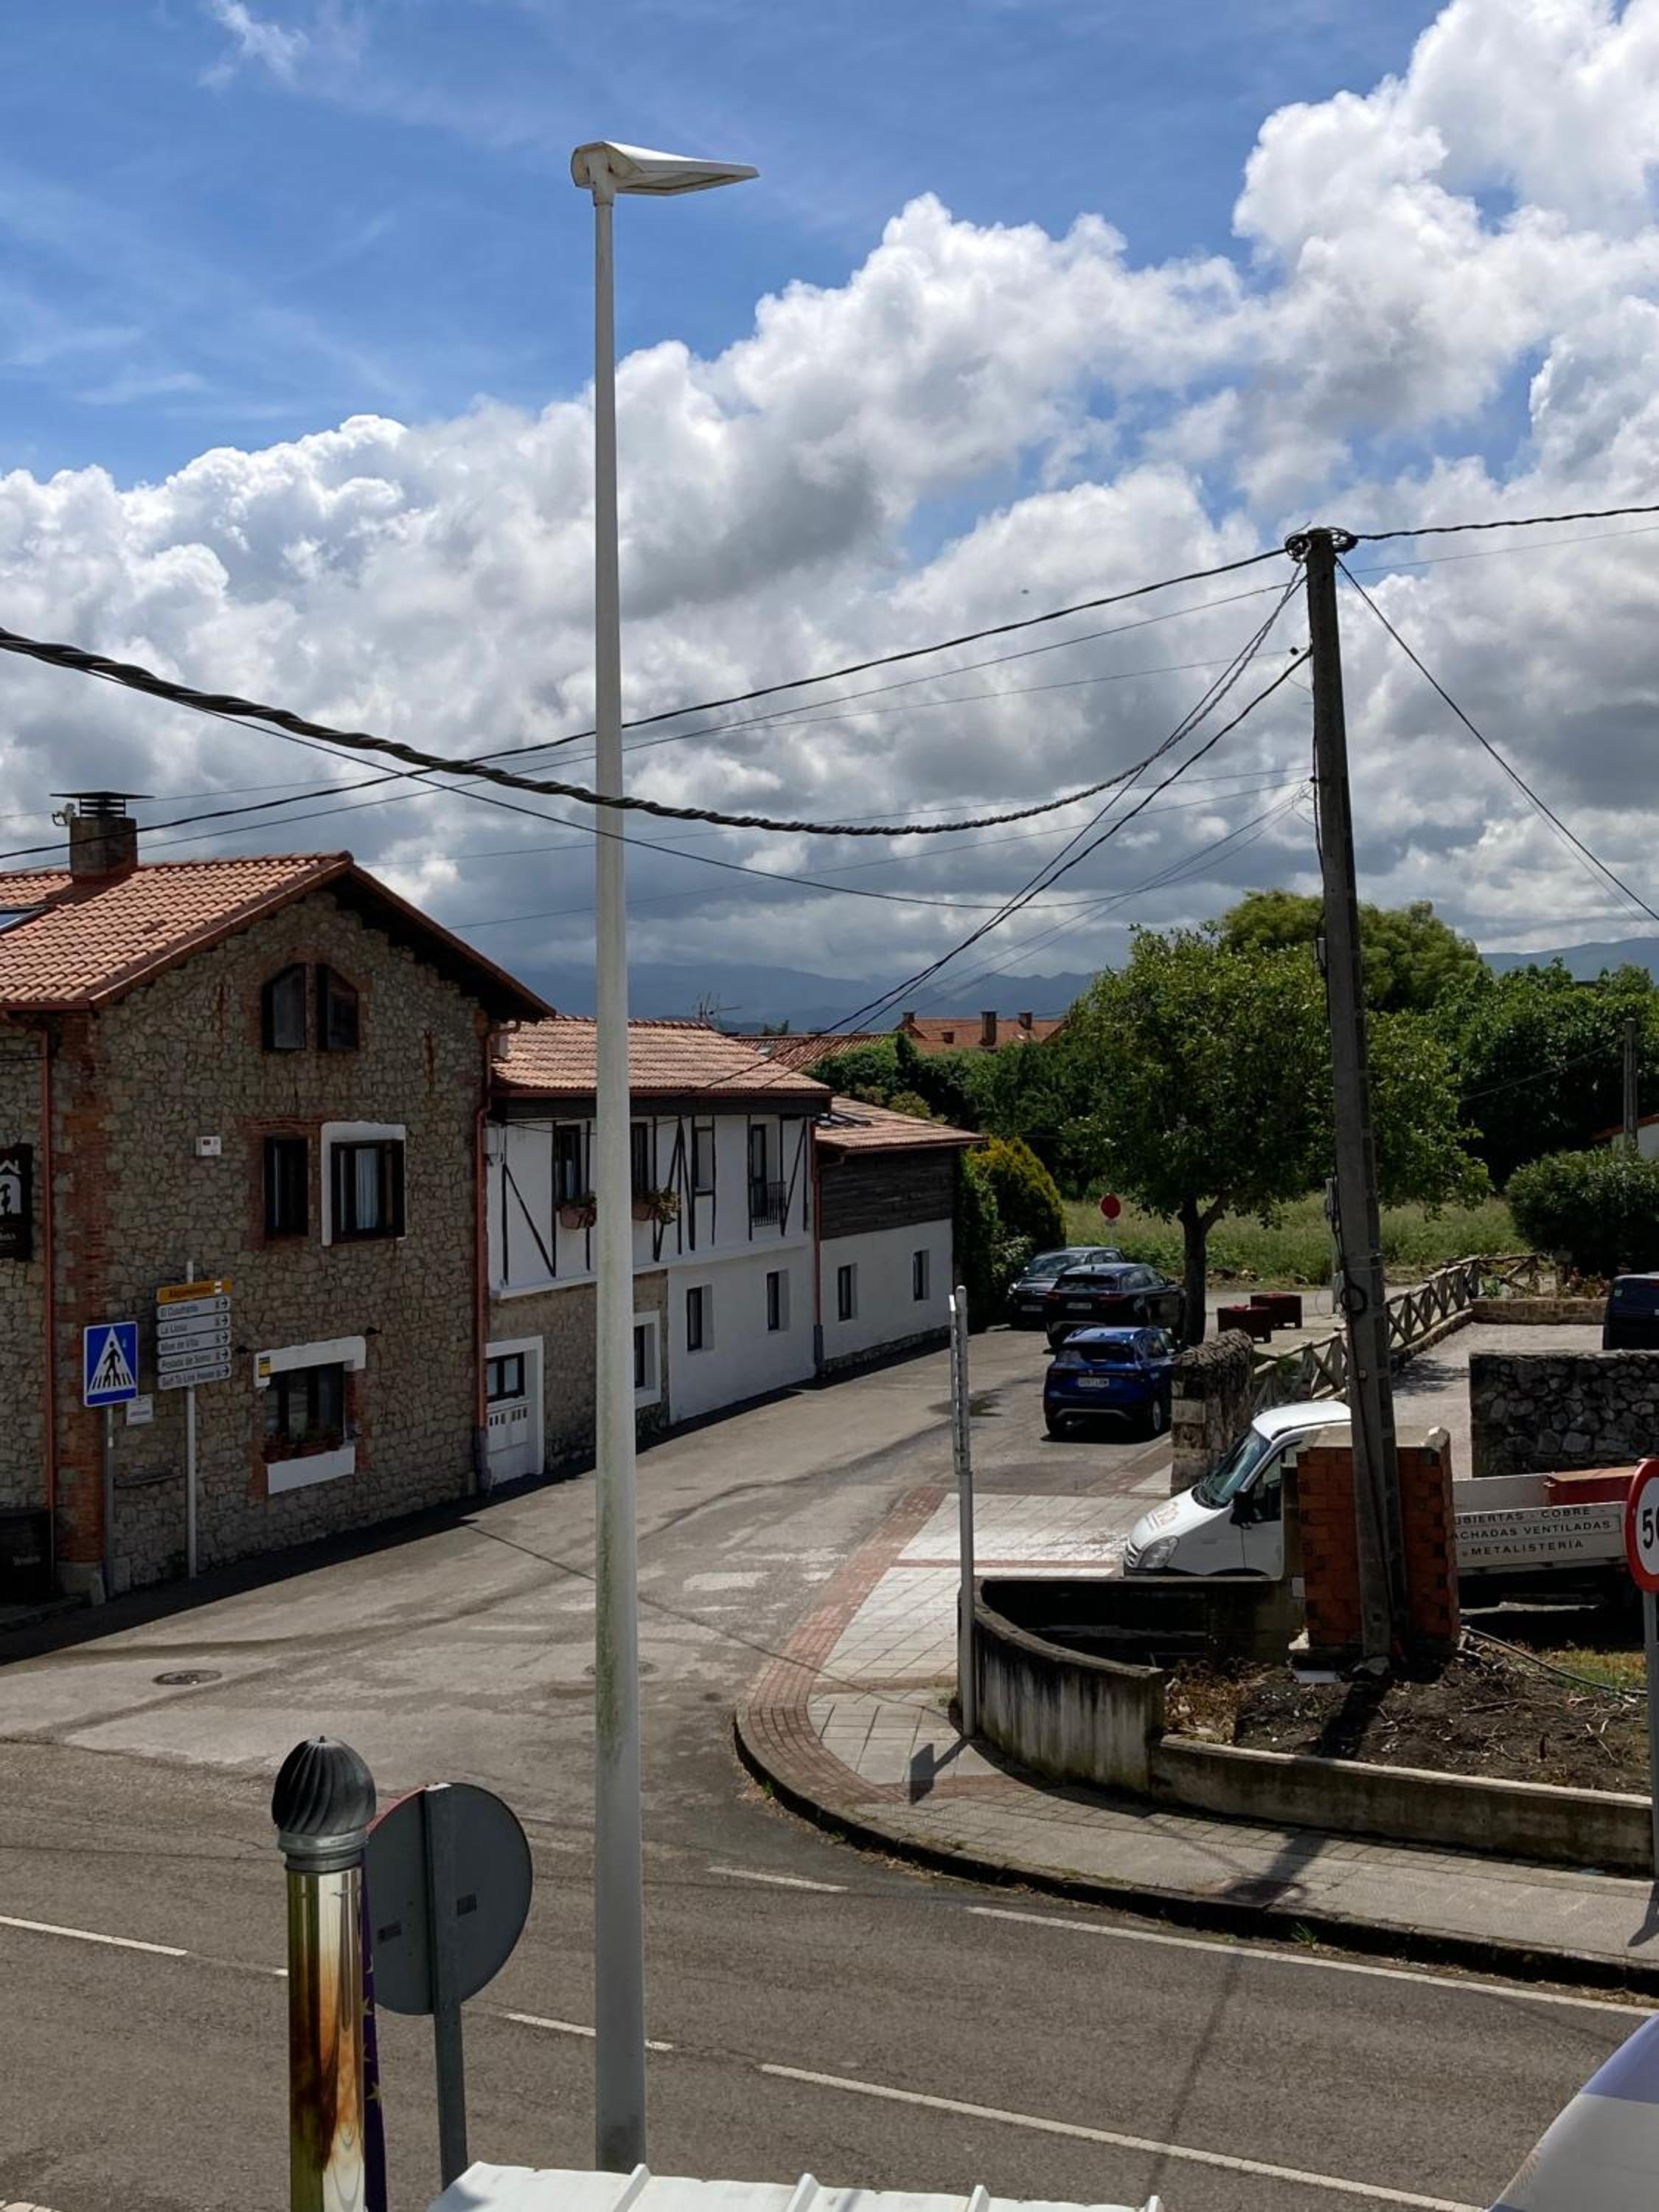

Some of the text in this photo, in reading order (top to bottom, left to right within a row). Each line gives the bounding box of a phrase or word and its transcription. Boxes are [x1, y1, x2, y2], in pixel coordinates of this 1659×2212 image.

[1455, 1508, 1590, 1526] UBIERTAS COBRE
[1453, 1520, 1612, 1540] ACHADAS VENTILADAS
[1642, 1508, 1659, 1550] 5
